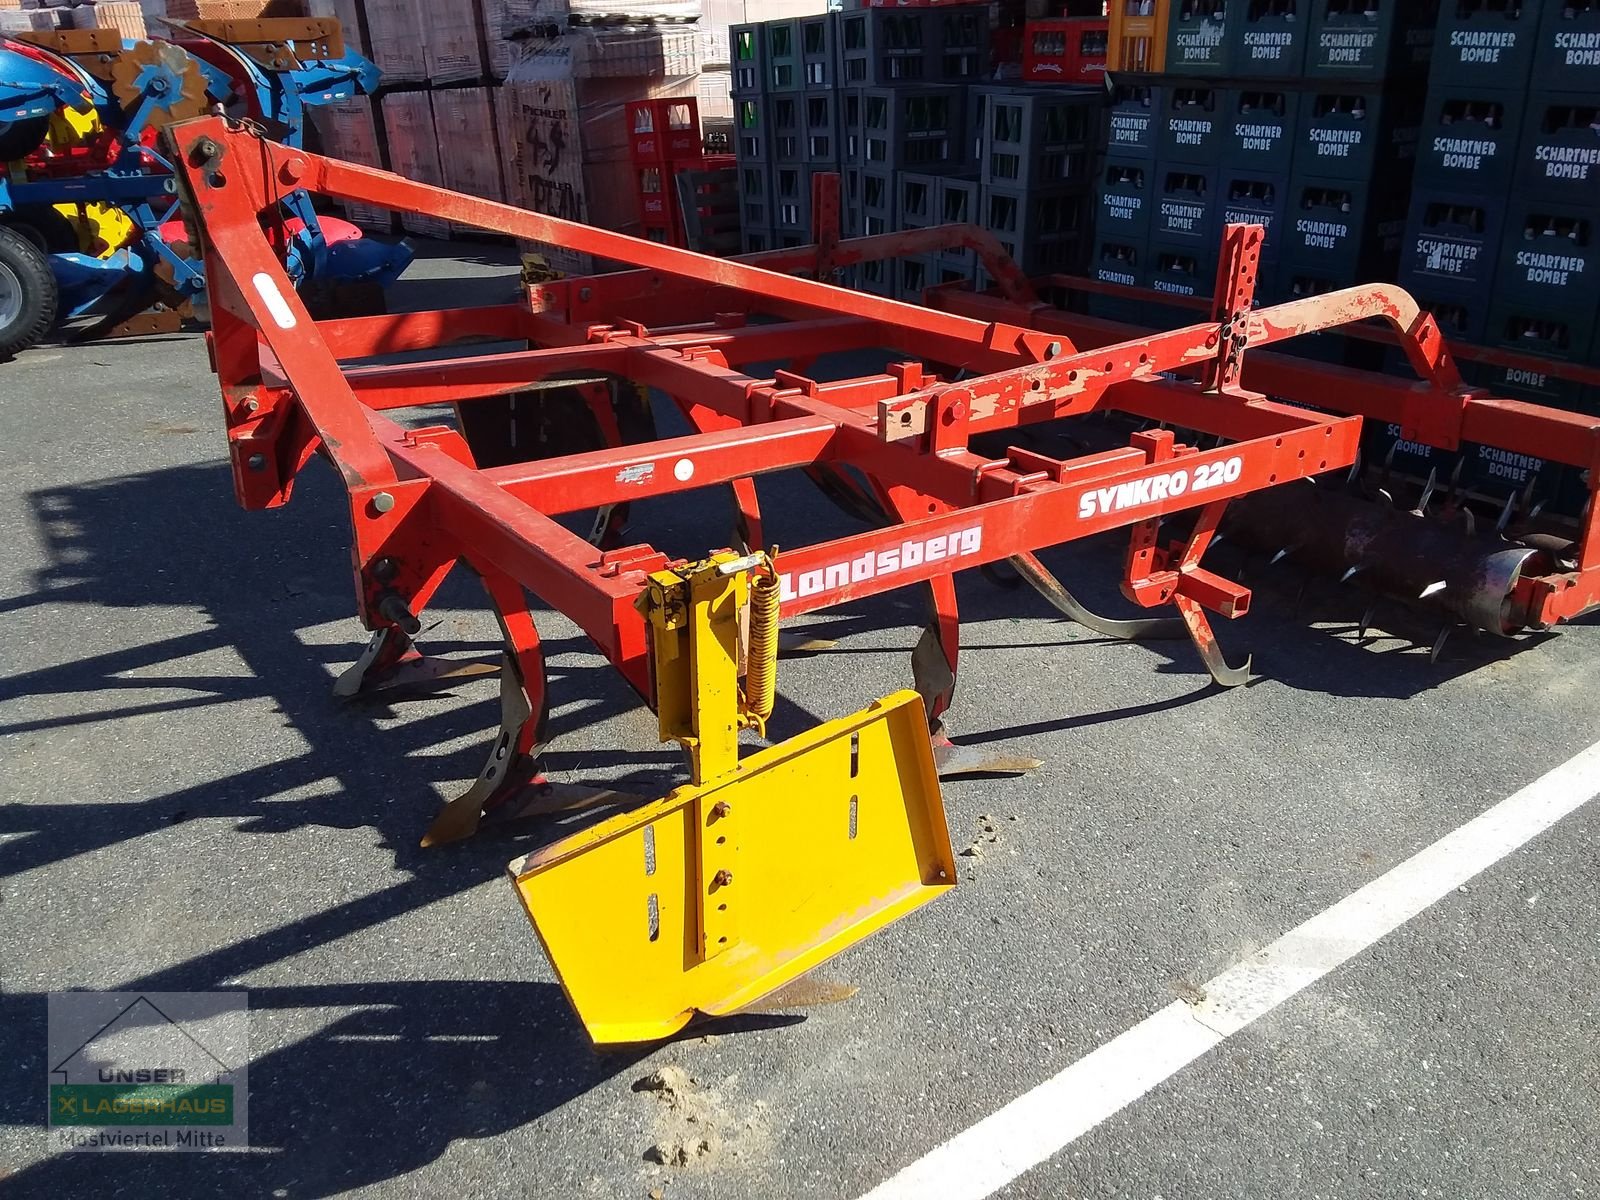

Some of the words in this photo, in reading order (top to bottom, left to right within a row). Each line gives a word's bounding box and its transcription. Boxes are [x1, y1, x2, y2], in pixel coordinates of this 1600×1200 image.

[1177, 33, 1221, 47] SCHARTNER
[1244, 32, 1292, 46] SCHARTNER
[1320, 33, 1373, 48] SCHARTNER
[1450, 30, 1516, 47] SCHARTNER
[1184, 47, 1211, 60] BOMBE
[1252, 46, 1281, 60] BOMBE
[1328, 48, 1361, 62] BOMBE
[1460, 47, 1501, 63] BOMBE
[522, 104, 567, 120] PICHLER
[1169, 118, 1212, 134] SCHARTNER
[1235, 123, 1282, 139] SCHARTNER
[1115, 129, 1140, 142] BOMBE
[1176, 132, 1202, 145] BOMBE
[1309, 127, 1362, 144] SCHARTNER
[1242, 137, 1271, 151] BOMBE
[1317, 143, 1350, 157] BOMBE
[1433, 137, 1497, 156] SCHARTNER
[1443, 153, 1481, 170] BOMBE
[1535, 145, 1600, 164] SCHARTNE
[1545, 162, 1589, 179] BOMBE
[1103, 193, 1141, 209] SCHARTNER
[1110, 207, 1133, 220] BOMBE
[1161, 203, 1202, 218] SCHARTNER
[1167, 216, 1194, 230] BOMBE
[1296, 218, 1348, 238] SCHARTNER
[1304, 233, 1336, 249] BOMBE
[1416, 239, 1478, 261] SCHARTNER
[1426, 255, 1463, 273] BMBE
[1516, 251, 1585, 273] SCHARTNER
[1098, 268, 1135, 285] SCHARTNER
[1527, 268, 1569, 286] BOMBE
[1505, 368, 1546, 387] BOMBE
[1396, 439, 1432, 457] BOMBE
[1479, 445, 1543, 471] SCHARTNER
[1488, 463, 1527, 482] BOMBE
[1079, 469, 1189, 518] SYNKRO
[1192, 456, 1242, 491] 220
[780, 525, 982, 602] Landsberg
